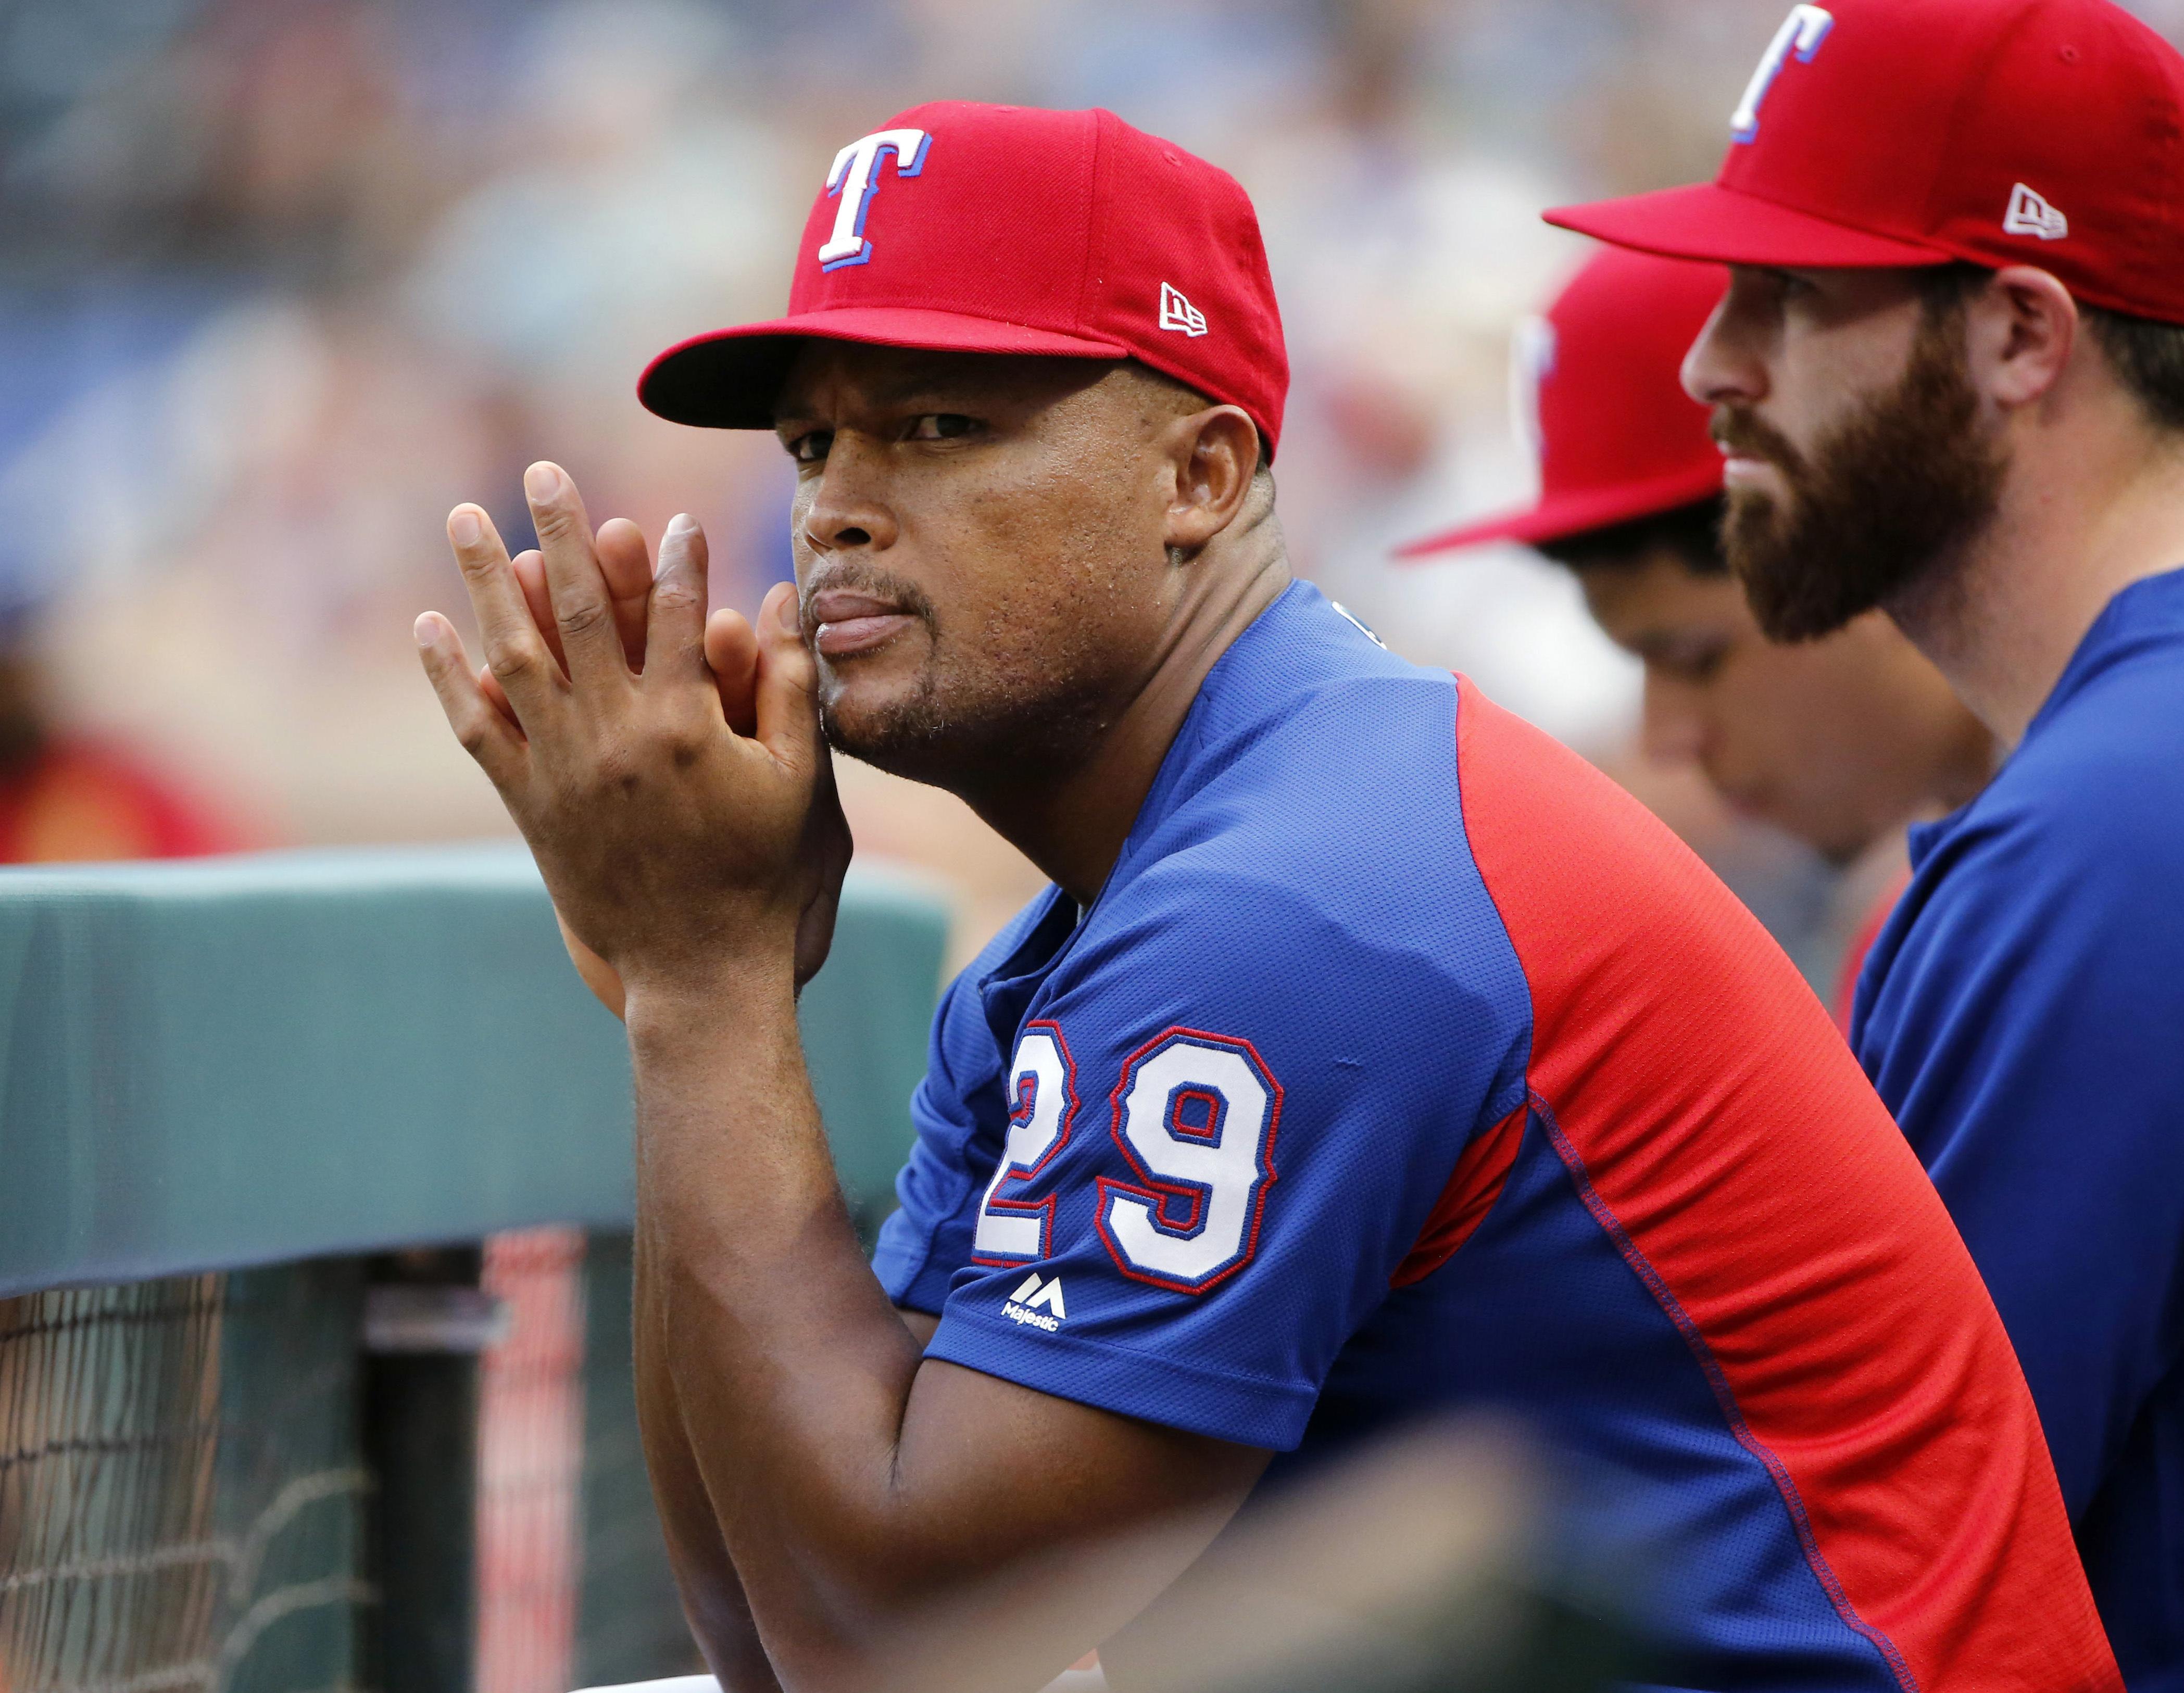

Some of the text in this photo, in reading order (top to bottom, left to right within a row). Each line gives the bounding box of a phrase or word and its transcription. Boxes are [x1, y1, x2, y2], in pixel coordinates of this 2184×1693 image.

[818, 128, 933, 272] T
[971, 1019, 1284, 1295] 29
[1000, 1301, 1059, 1333] Majestic
